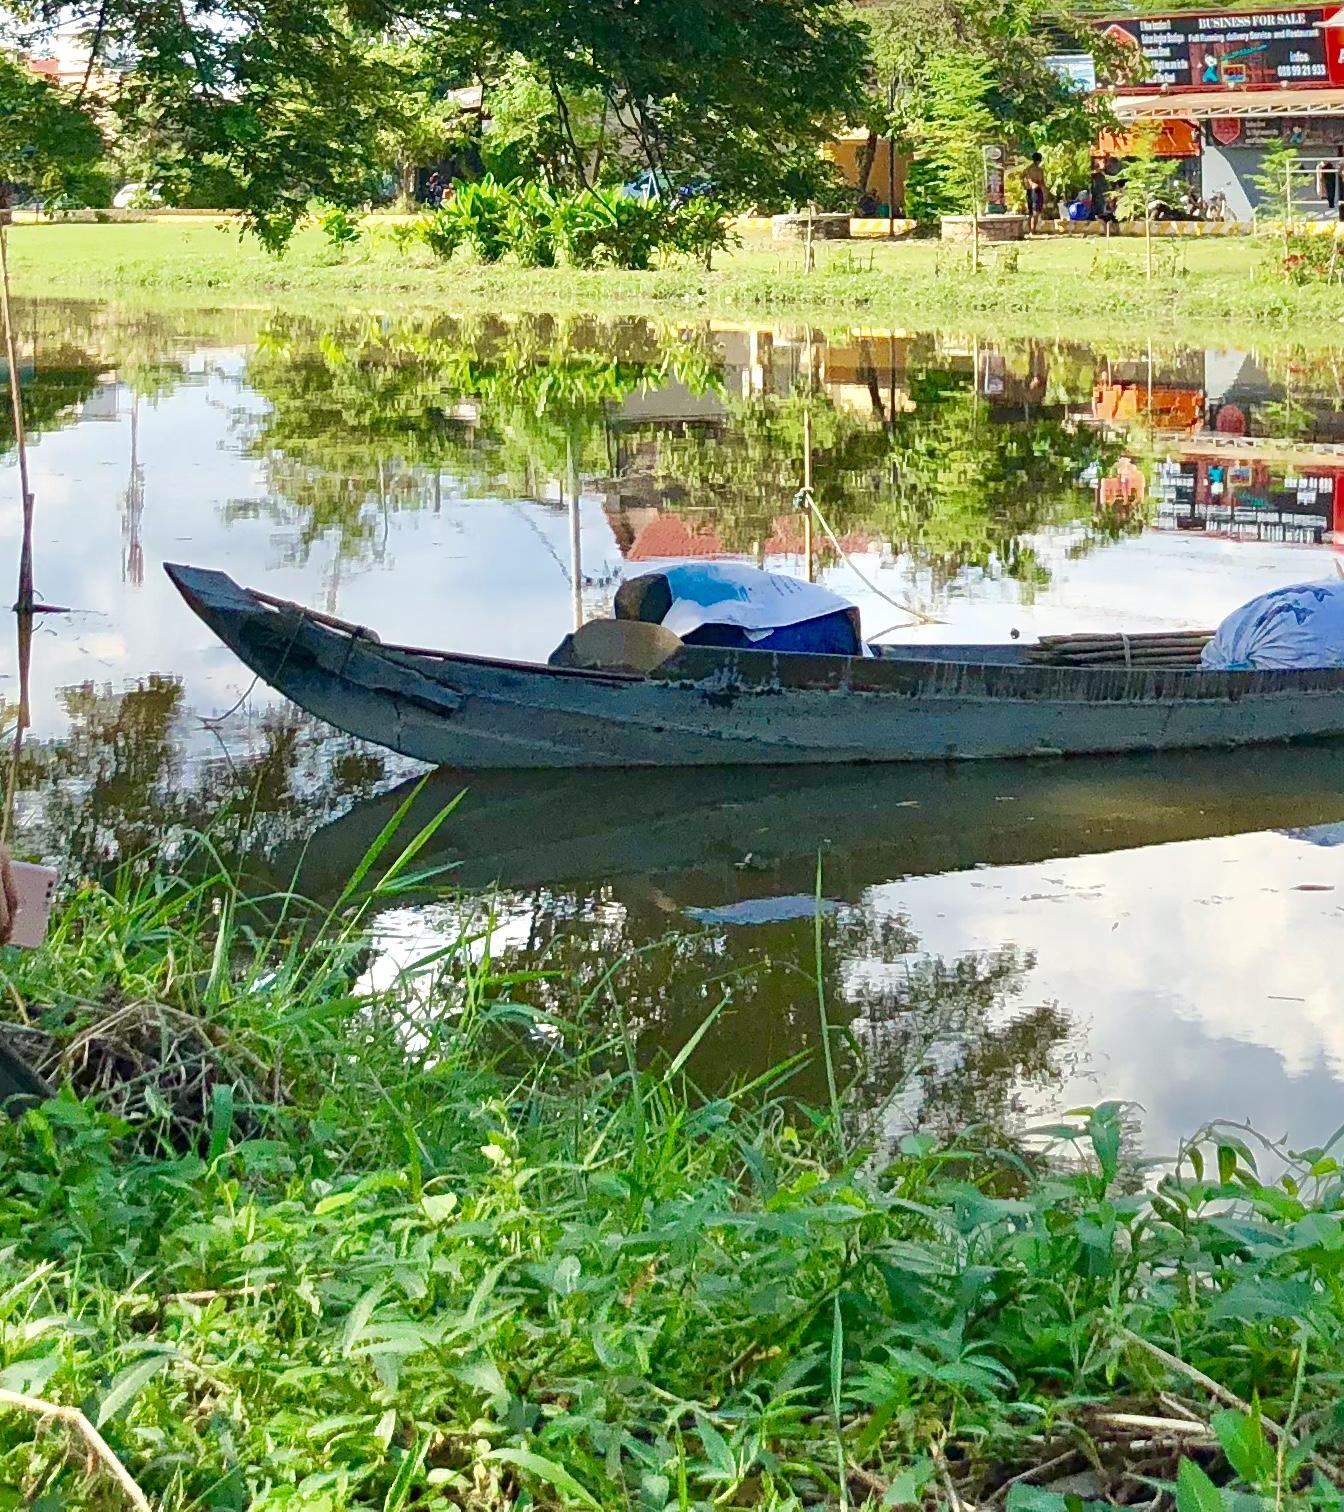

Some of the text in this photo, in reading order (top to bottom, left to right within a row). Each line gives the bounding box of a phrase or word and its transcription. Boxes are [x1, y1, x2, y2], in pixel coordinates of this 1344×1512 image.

[1198, 13, 1306, 29] BUSINESS FOR SALE
[1302, 64, 1311, 76] 21
